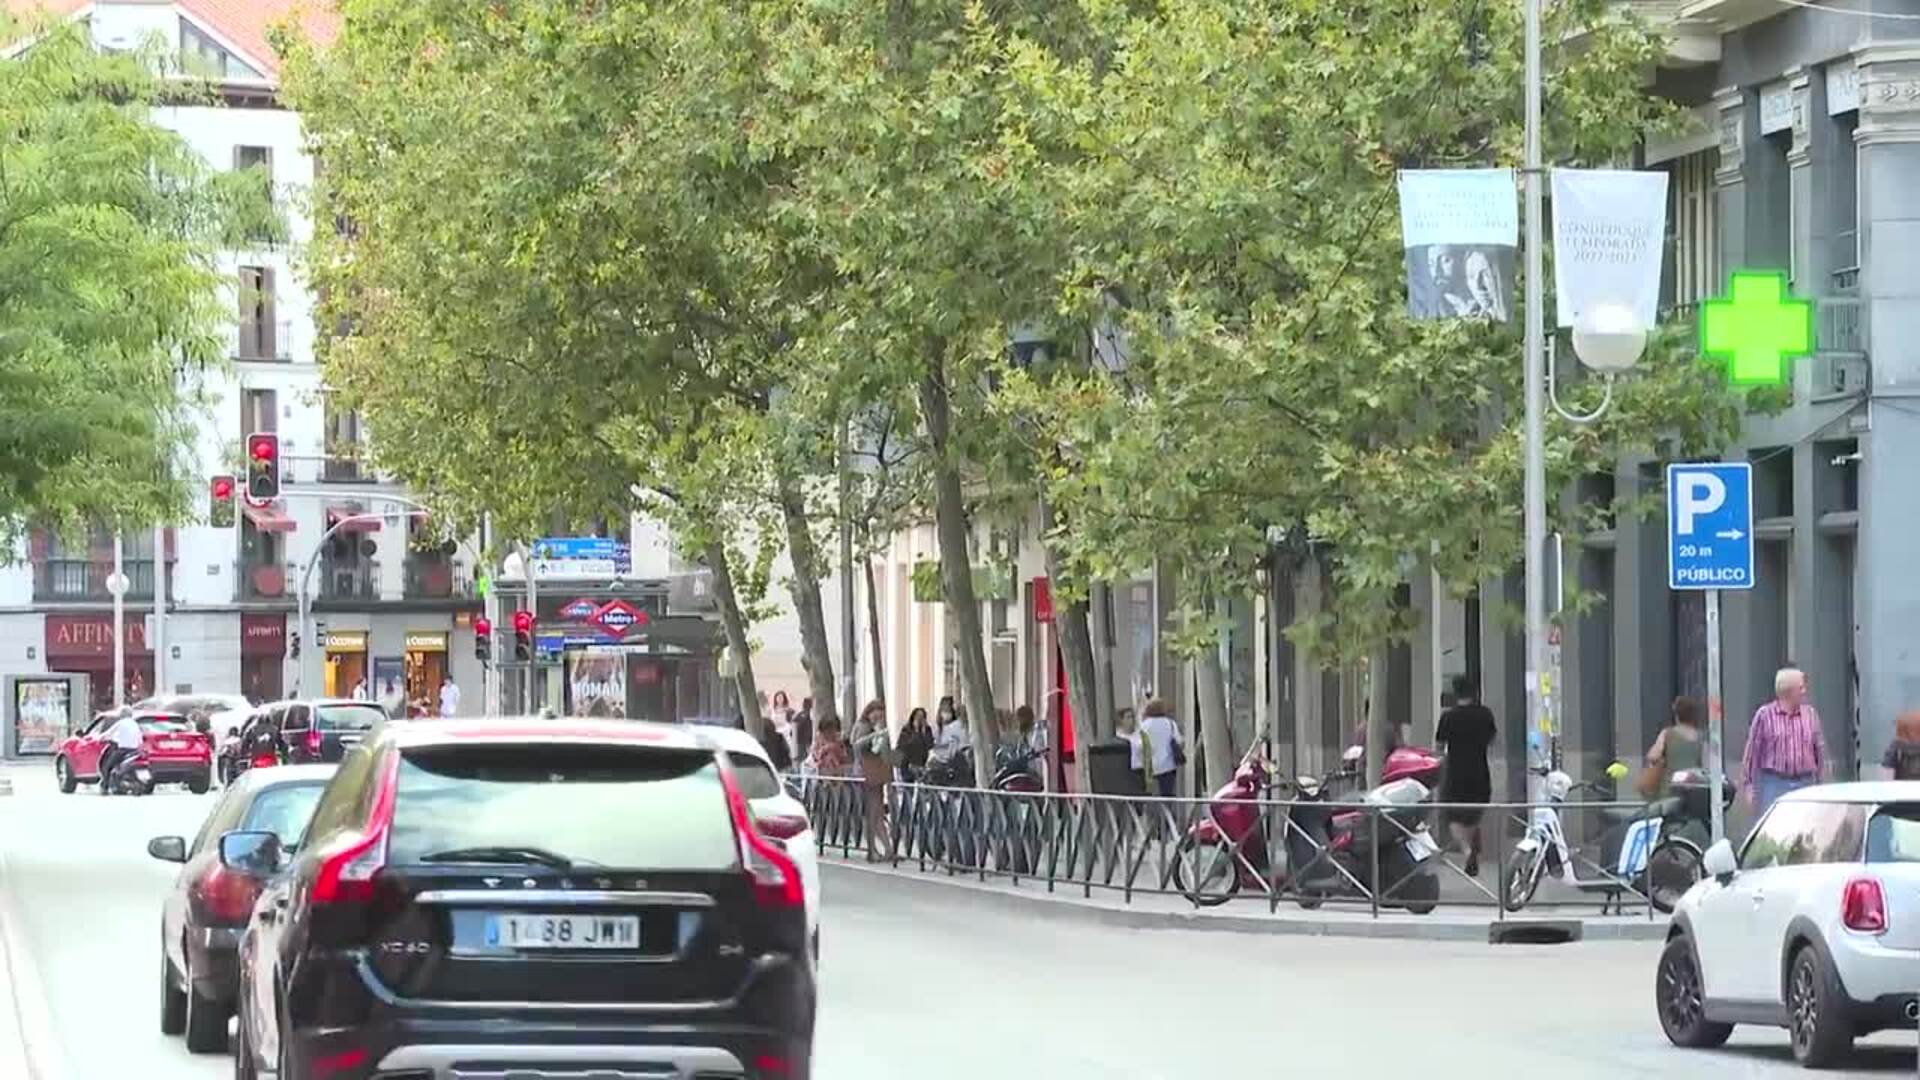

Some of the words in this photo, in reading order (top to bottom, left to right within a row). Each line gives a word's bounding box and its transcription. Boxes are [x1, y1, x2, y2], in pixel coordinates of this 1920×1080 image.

[1676, 472, 1727, 535] P
[1679, 545, 1696, 557] 20
[1677, 565, 1745, 581] PÚBLICO
[604, 614, 632, 624] Metro
